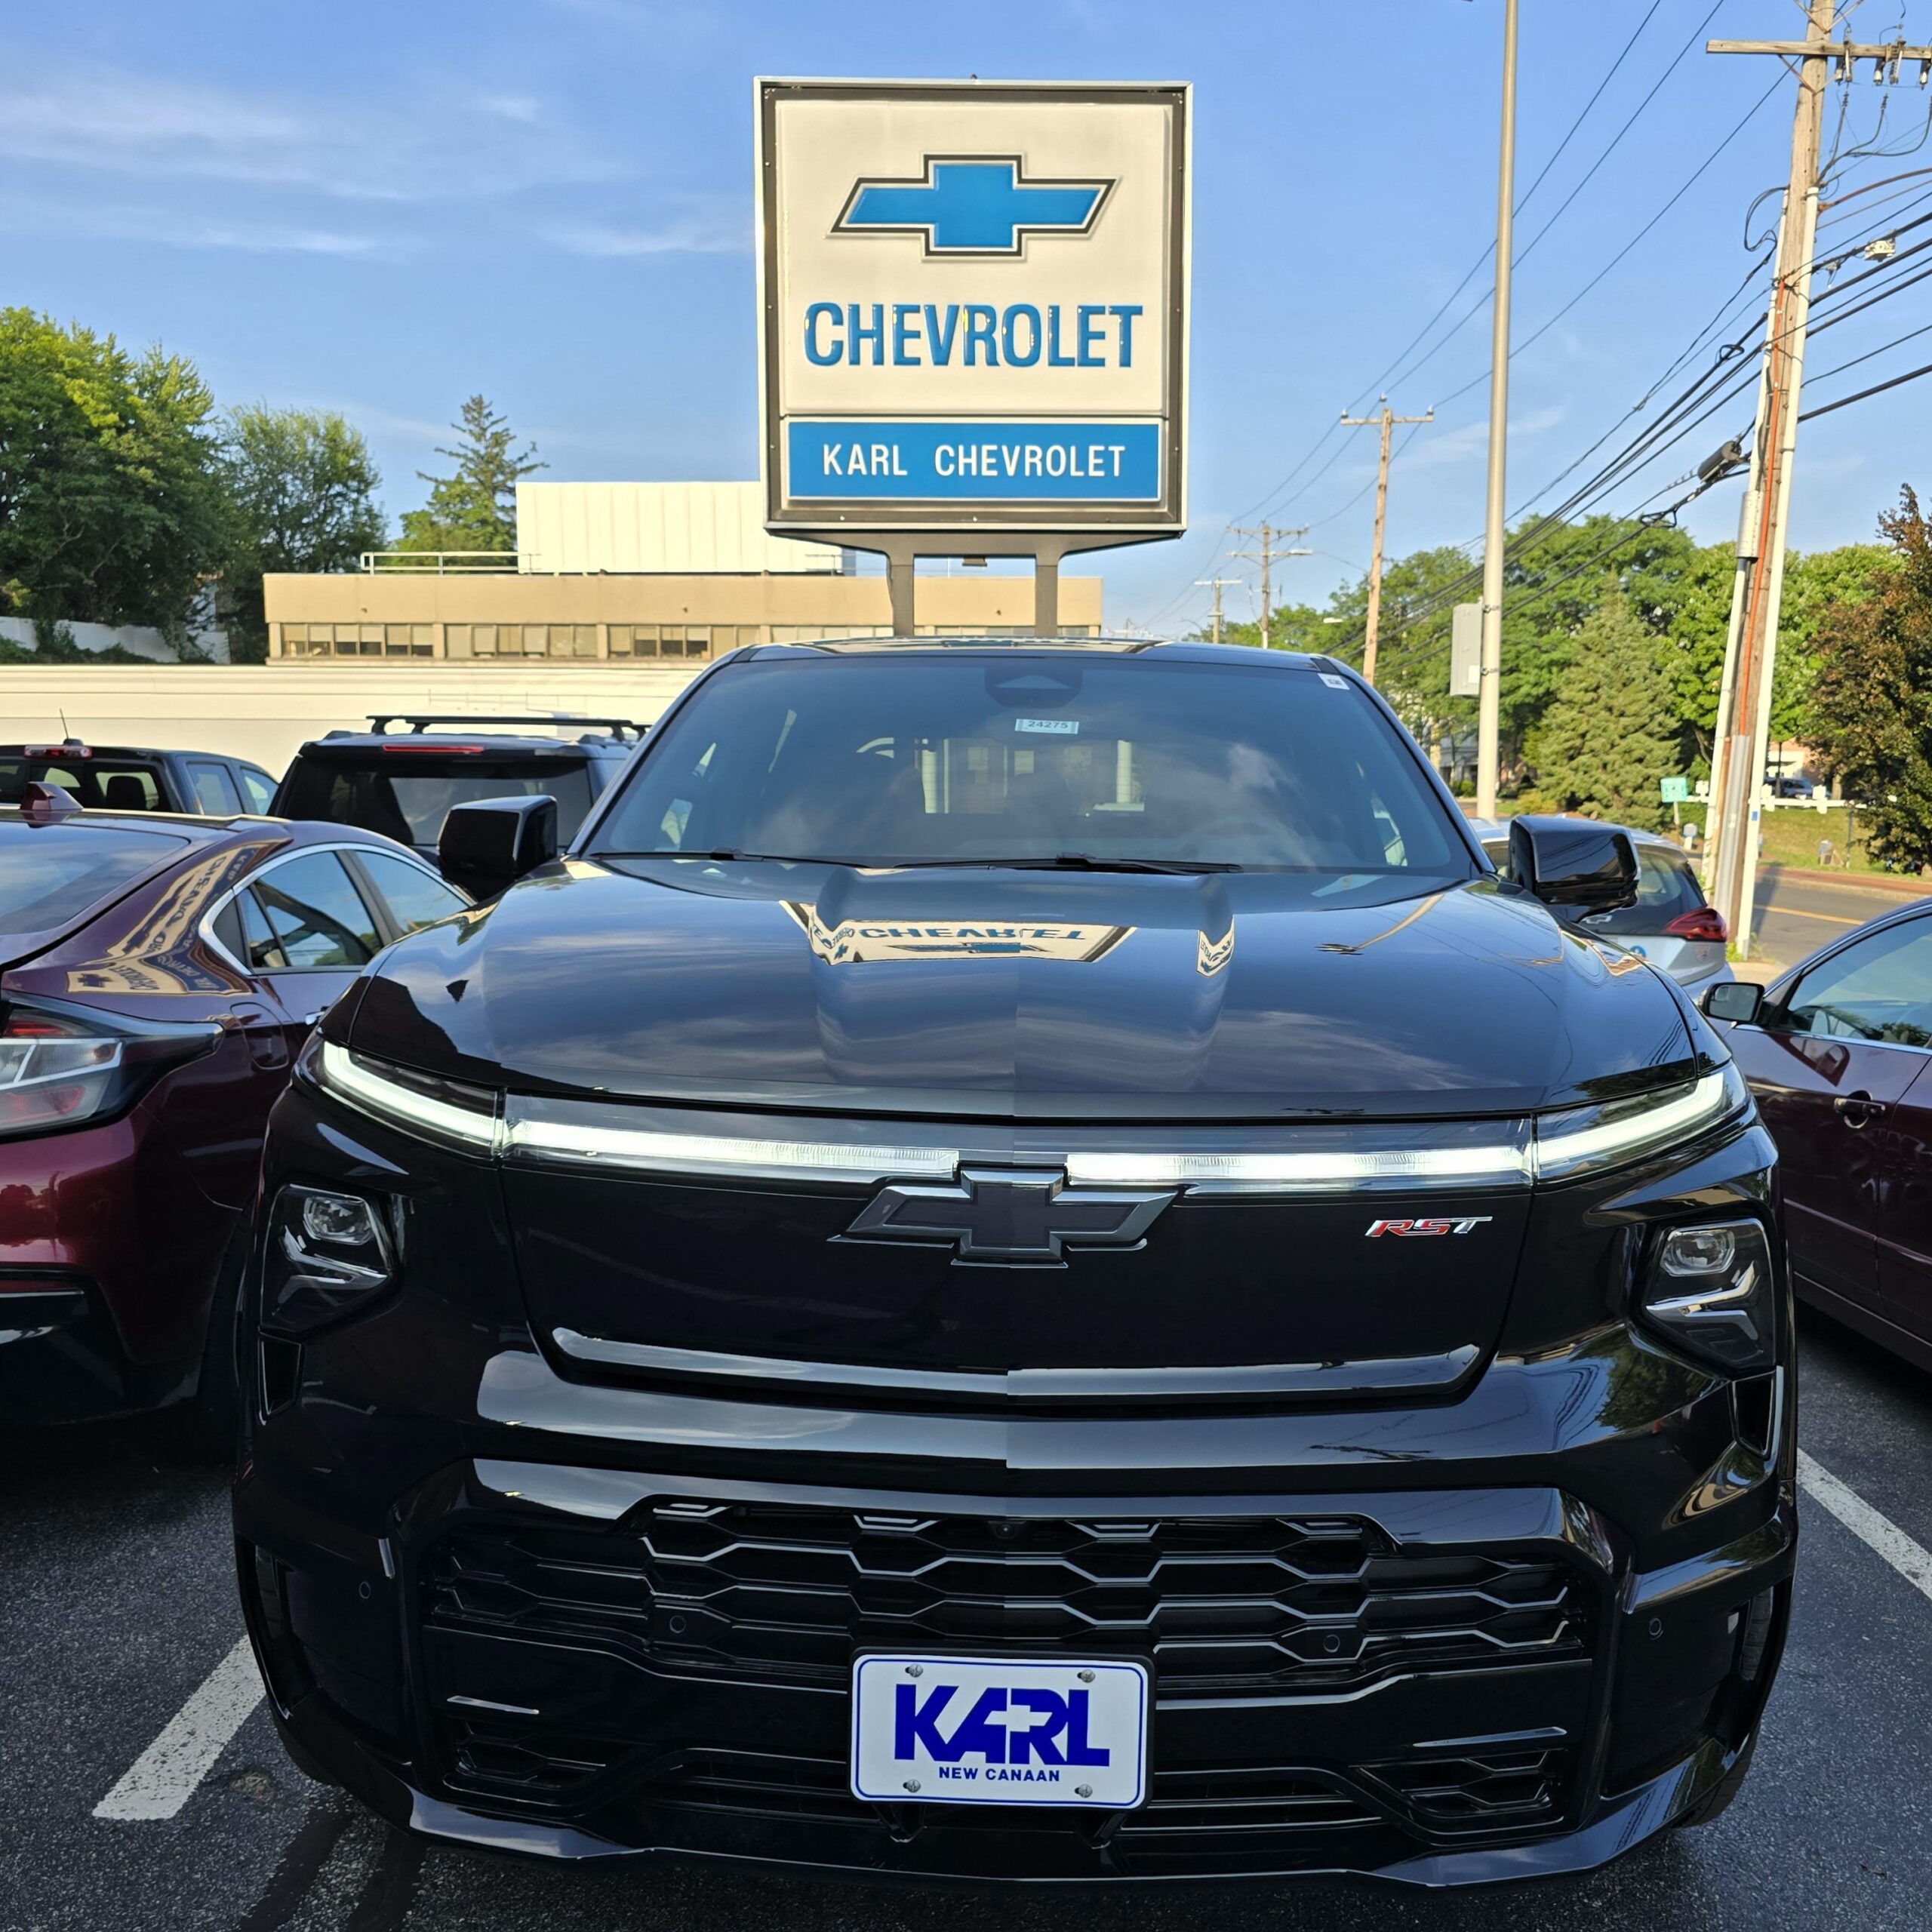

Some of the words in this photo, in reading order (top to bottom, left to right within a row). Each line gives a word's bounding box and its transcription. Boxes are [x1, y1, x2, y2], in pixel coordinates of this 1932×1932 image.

[804, 303, 1143, 368] CHEVROLET
[823, 444, 908, 477] KARL
[934, 445, 1126, 478] CHEVROLET
[1027, 720, 1069, 729] 24275
[1364, 1216, 1494, 1238] RST
[894, 1684, 1110, 1767] KARL
[938, 1767, 979, 1780] NEW
[985, 1768, 1060, 1783] CANAAN
